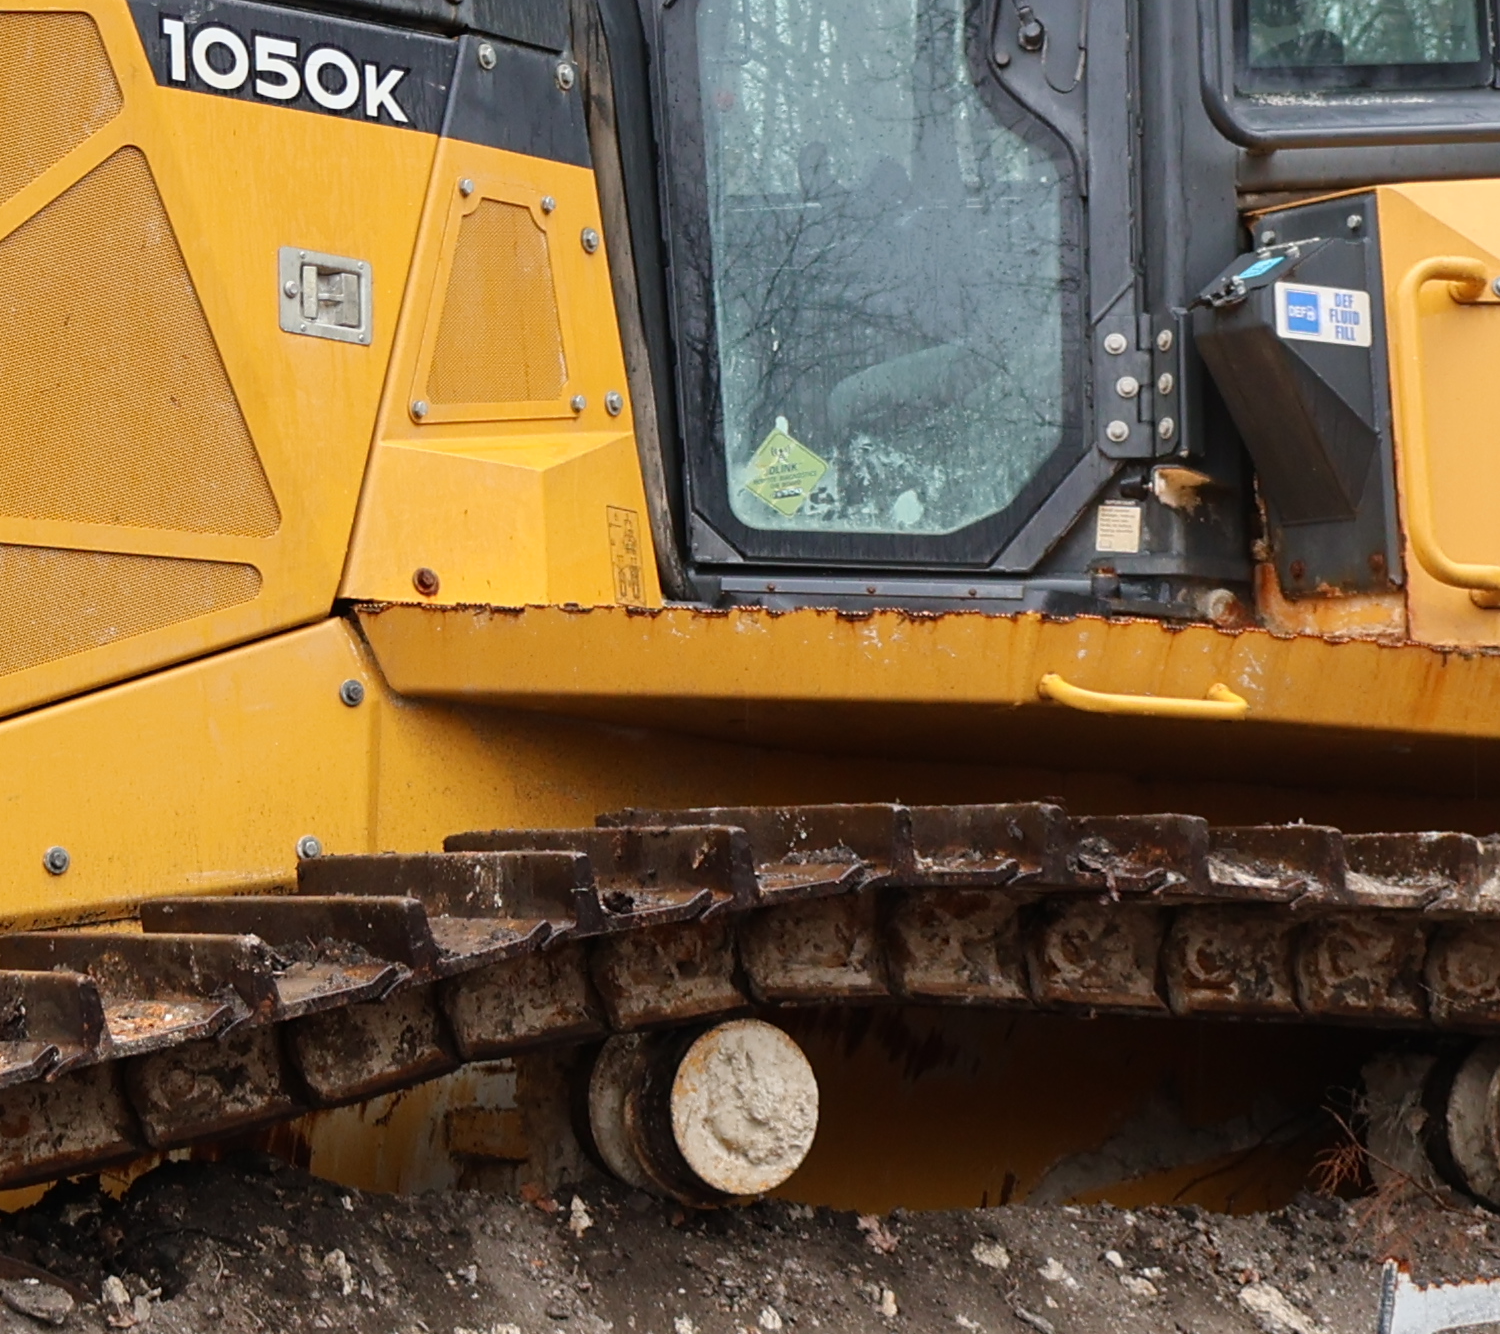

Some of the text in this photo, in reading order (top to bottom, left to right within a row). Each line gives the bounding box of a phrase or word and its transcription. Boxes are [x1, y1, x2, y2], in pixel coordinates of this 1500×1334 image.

[162, 17, 409, 123] 1050K
[1334, 292, 1353, 308] DEF
[1287, 304, 1307, 318] DEF
[1330, 308, 1360, 325] FLUID
[1335, 325, 1356, 342] FILL
